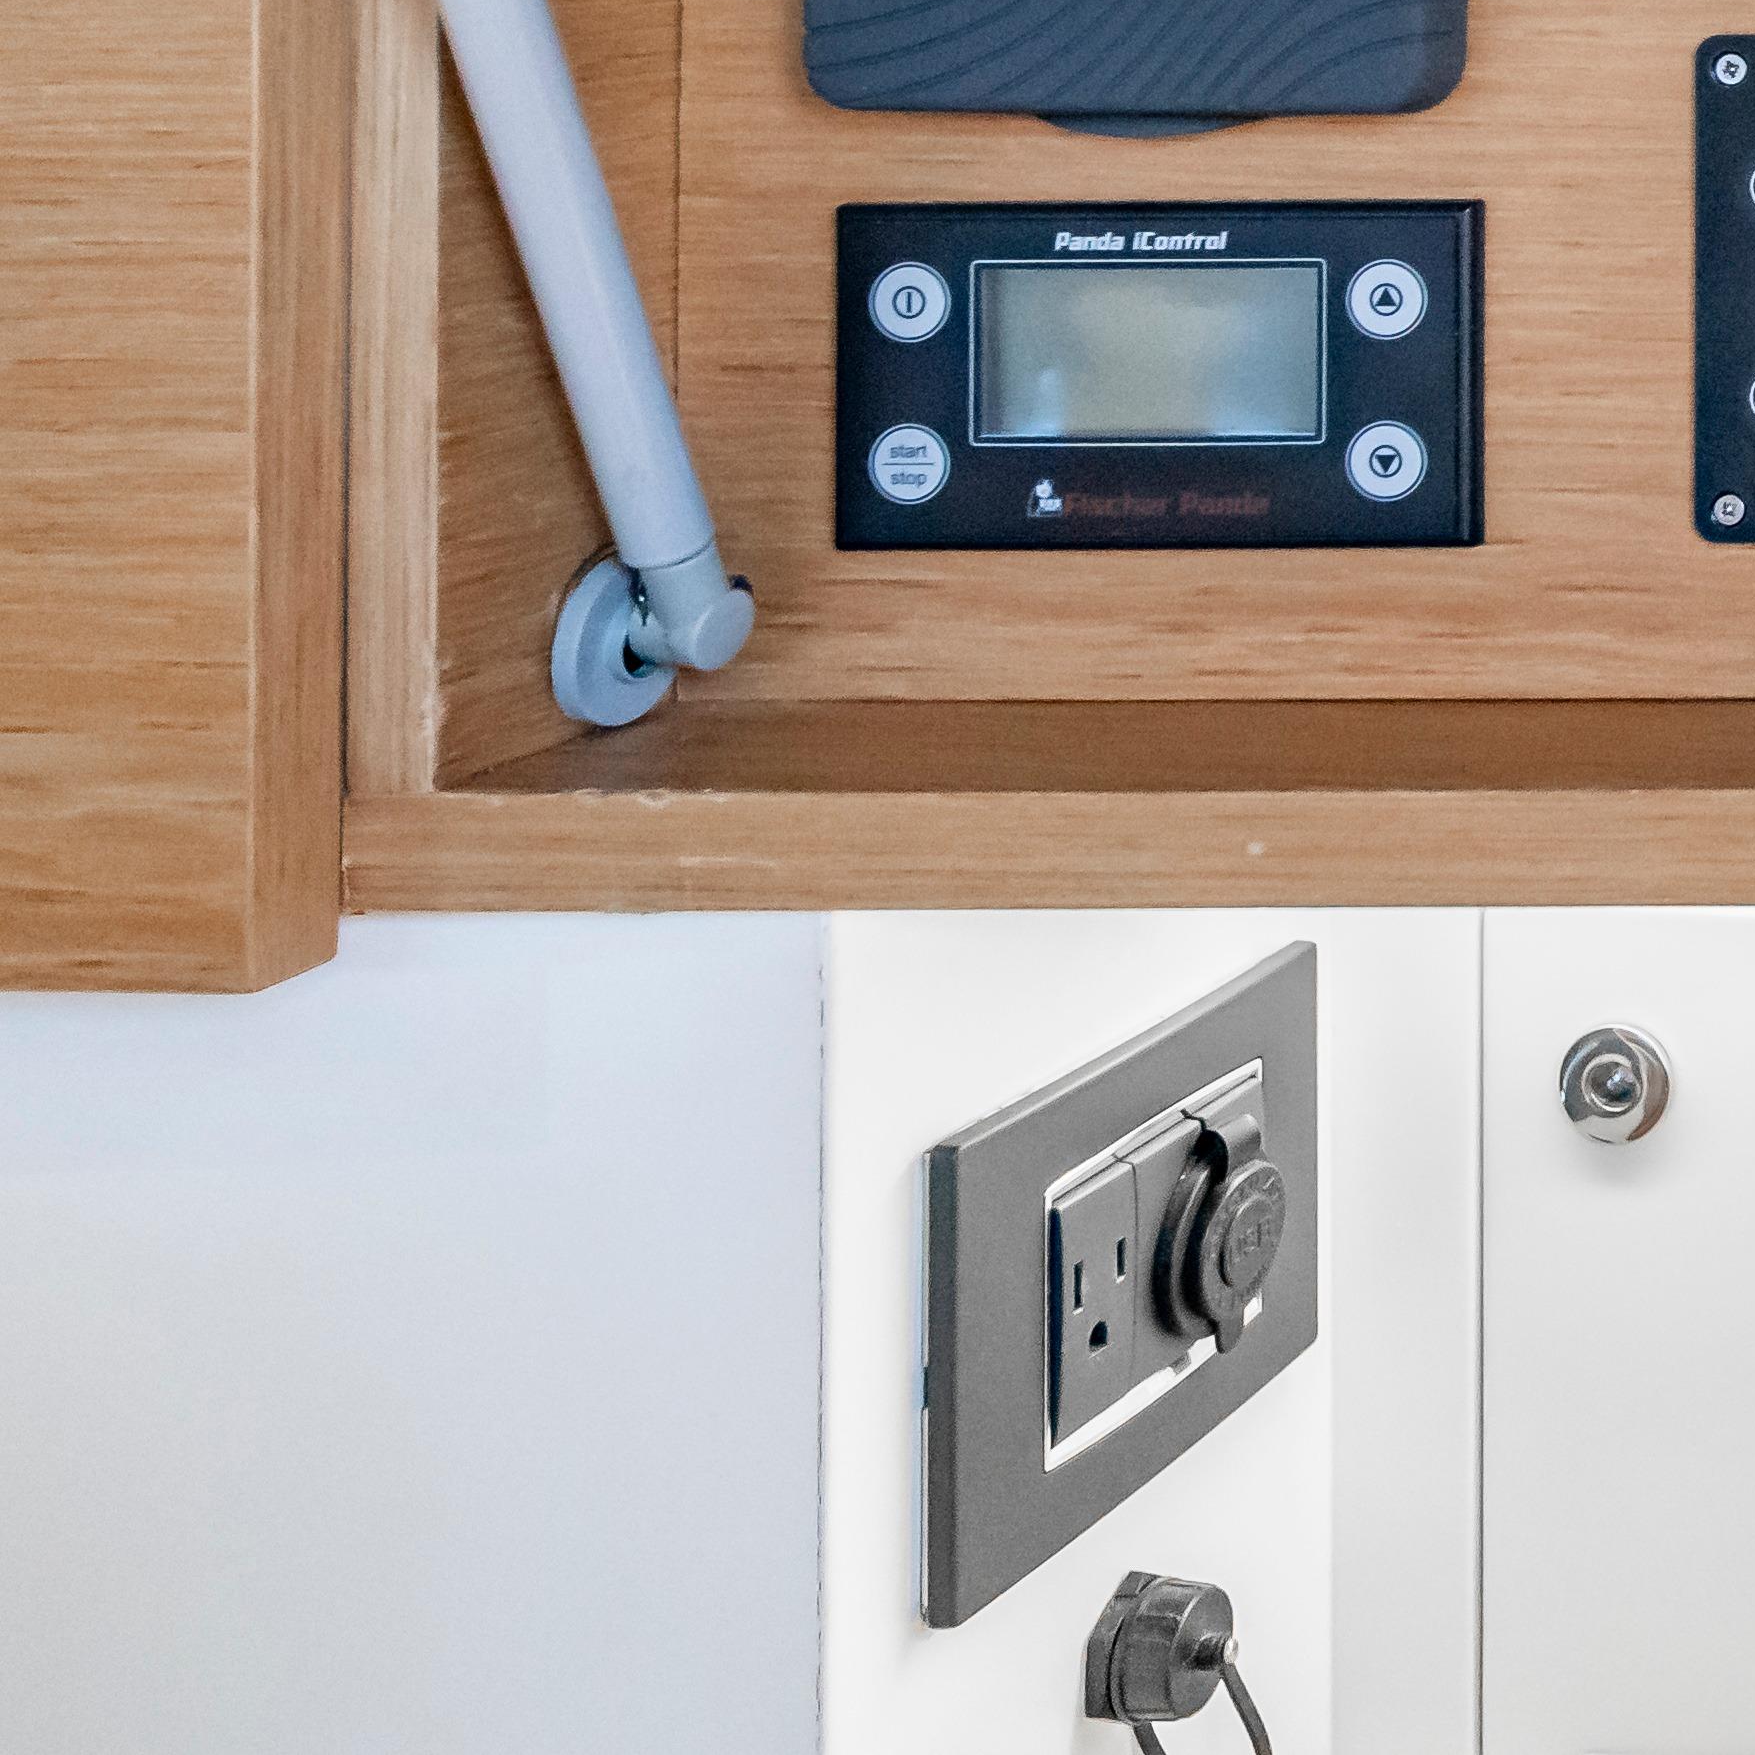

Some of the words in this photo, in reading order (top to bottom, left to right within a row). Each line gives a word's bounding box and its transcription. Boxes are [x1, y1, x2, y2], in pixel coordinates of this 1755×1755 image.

[1054, 232, 1126, 250] Panda
[1132, 231, 1228, 250] iControl
[890, 445, 928, 459] start
[890, 472, 928, 488] stop
